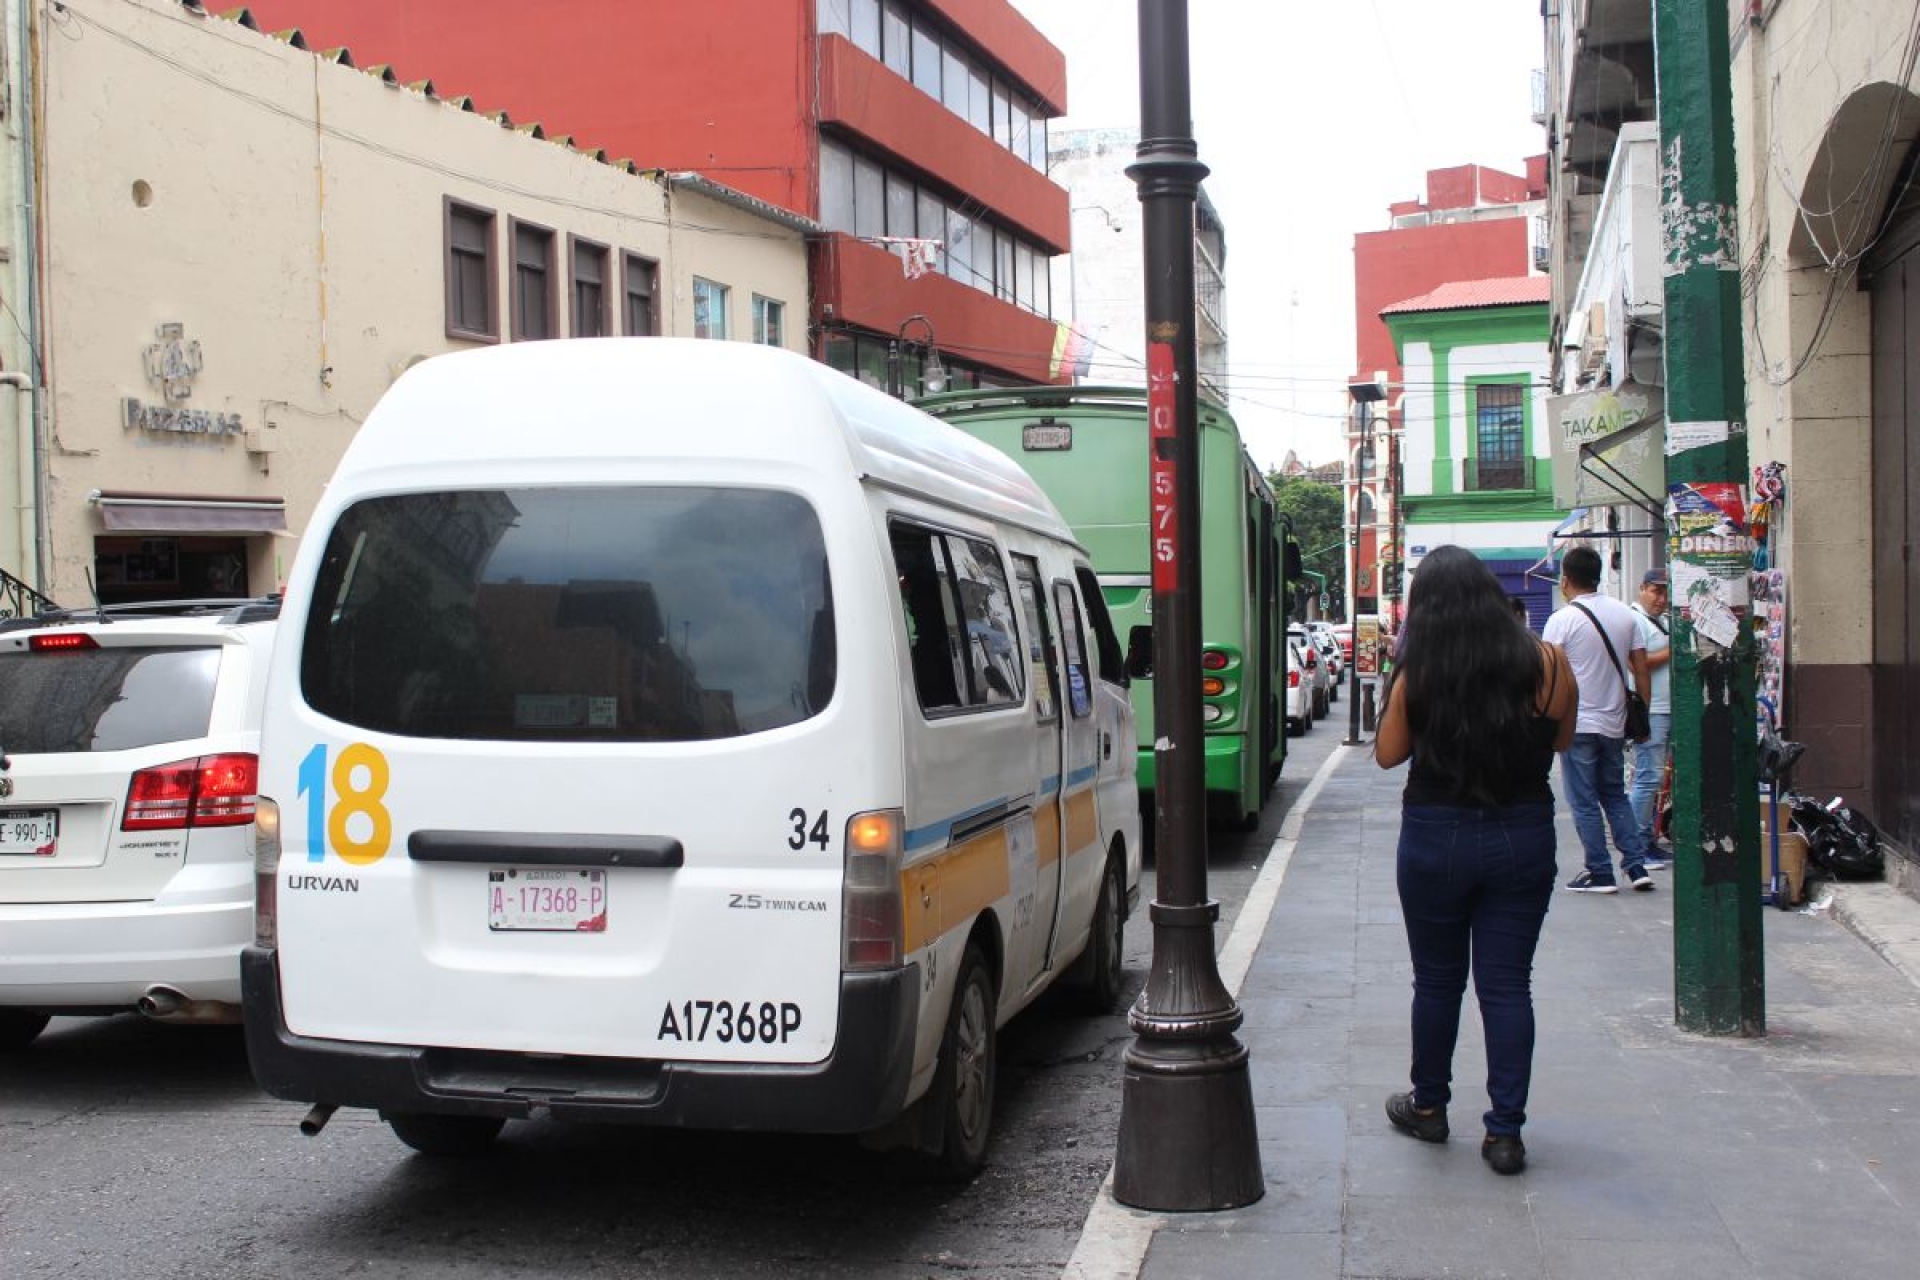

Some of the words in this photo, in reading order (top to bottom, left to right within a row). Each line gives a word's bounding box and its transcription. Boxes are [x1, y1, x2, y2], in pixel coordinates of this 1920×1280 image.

[297, 742, 392, 866] 18
[788, 808, 829, 851] 34
[288, 875, 359, 892] URVAN
[492, 886, 603, 914] A-17368-P
[729, 893, 762, 909] 2.5
[765, 899, 795, 911] TWIN
[798, 901, 827, 911] CAM
[657, 1000, 802, 1043] A17368P
